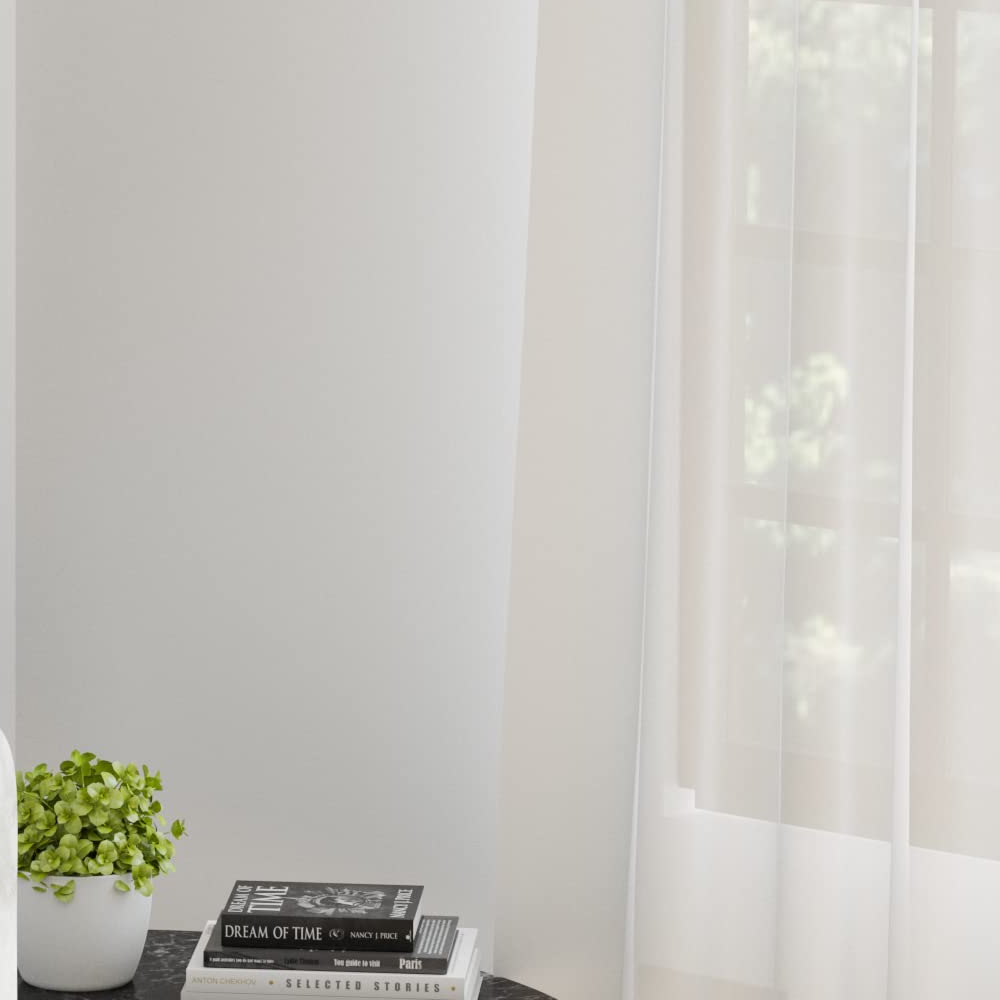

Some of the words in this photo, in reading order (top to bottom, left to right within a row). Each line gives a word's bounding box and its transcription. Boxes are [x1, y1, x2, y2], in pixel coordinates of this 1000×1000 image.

[228, 893, 250, 913] DREAM
[246, 885, 289, 914] TIME
[224, 924, 269, 939] DREAM
[272, 925, 289, 940] OF
[291, 926, 323, 941] TIME
[350, 931, 373, 939] NANCY
[380, 932, 398, 940] PRICE
[345, 959, 361, 968] guide
[362, 959, 368, 967] to
[369, 959, 381, 967] visit
[399, 958, 423, 970] Paris
[191, 976, 218, 985] ANTON
[219, 977, 257, 985] CHEKHOV
[286, 978, 362, 991] SELECTED
[374, 981, 440, 993] STORIES
